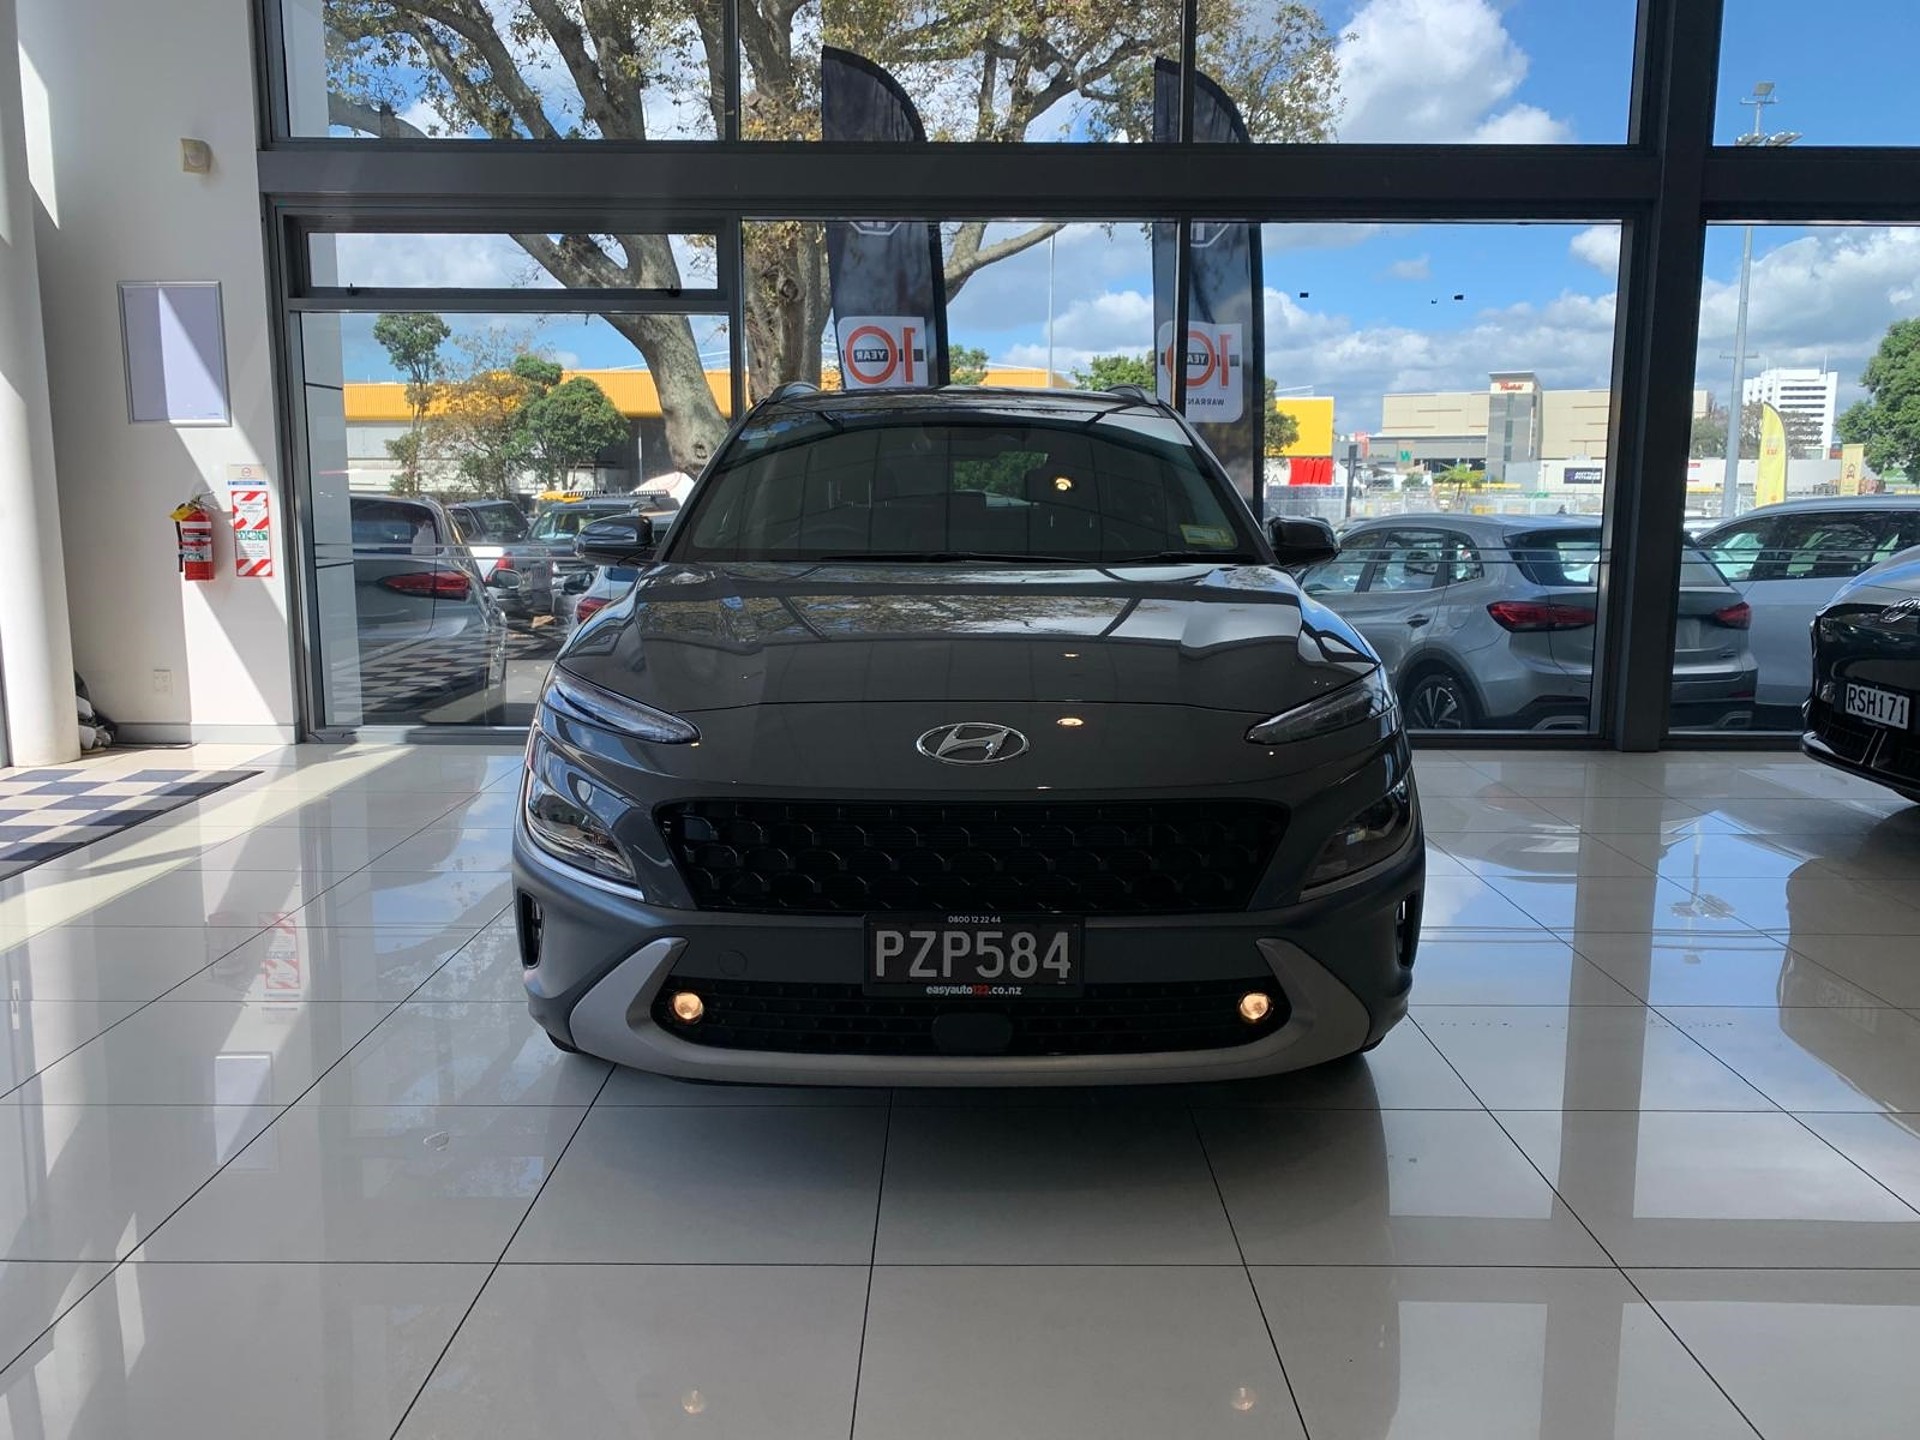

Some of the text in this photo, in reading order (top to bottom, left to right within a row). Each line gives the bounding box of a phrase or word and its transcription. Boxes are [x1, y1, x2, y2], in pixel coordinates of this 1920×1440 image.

[1847, 686, 1905, 725] RSH171
[948, 915, 1001, 924] 0800 12 22 44
[876, 930, 1071, 978] PZP584
[926, 984, 1022, 996] easyauto123.co.nz
